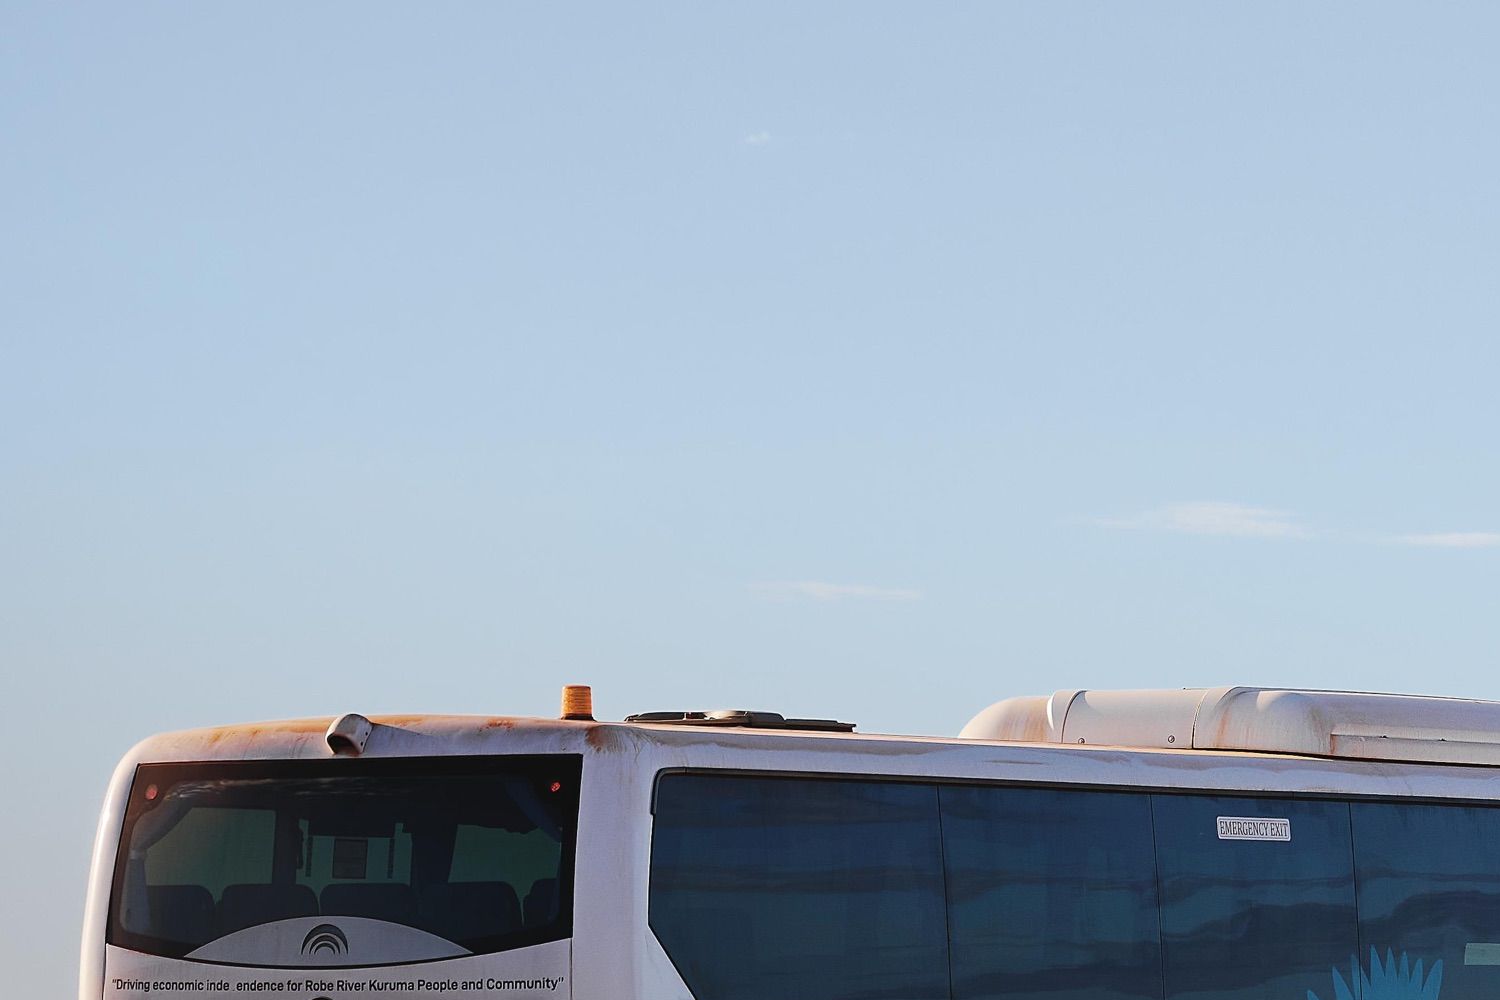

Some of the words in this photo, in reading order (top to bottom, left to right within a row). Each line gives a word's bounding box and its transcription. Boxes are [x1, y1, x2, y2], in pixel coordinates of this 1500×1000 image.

[1220, 820, 1268, 836] EMERGENCY
[1270, 822, 1288, 837] EXIT
[153, 980, 204, 991] economic
[287, 980, 302, 991] for
[306, 980, 334, 991] Robe
[337, 980, 366, 991] River
[369, 980, 414, 991] Kuruma
[418, 979, 458, 992] People
[461, 978, 483, 990] and
